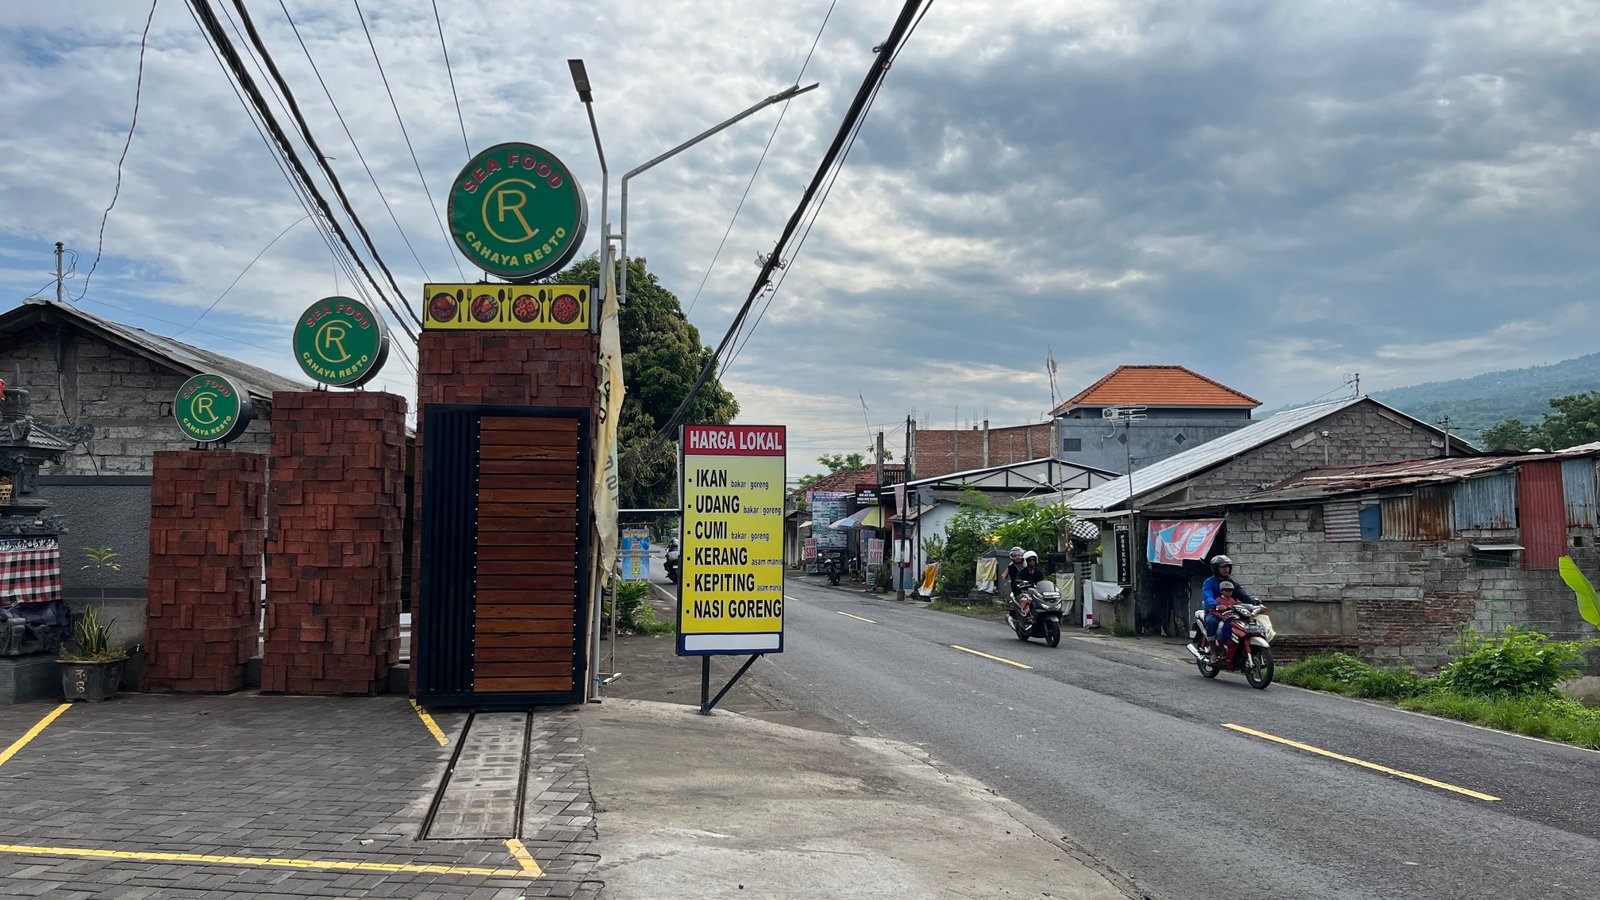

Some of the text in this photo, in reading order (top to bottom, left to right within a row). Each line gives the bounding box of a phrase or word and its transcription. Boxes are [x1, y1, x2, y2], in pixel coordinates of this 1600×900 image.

[464, 153, 563, 194] SEA FOOD
[465, 227, 565, 266] CAHAYA RESTO
[306, 304, 370, 329] SEA FOOD
[303, 352, 368, 378] CAHAYA RESTO
[182, 380, 231, 400] SEA FOOD
[183, 415, 232, 435] CAHAYA RESTO
[690, 430, 782, 450] HARGA LOKAL
[696, 469, 727, 487] IKAN
[750, 481, 769, 490] goreng
[696, 495, 740, 513] UDANG
[763, 507, 781, 515] goreng
[695, 521, 727, 539] CUMI
[751, 533, 769, 541] goreng
[694, 547, 748, 566] KERANG
[694, 573, 755, 592] KEPITING
[694, 599, 782, 618] NASI GORENG
